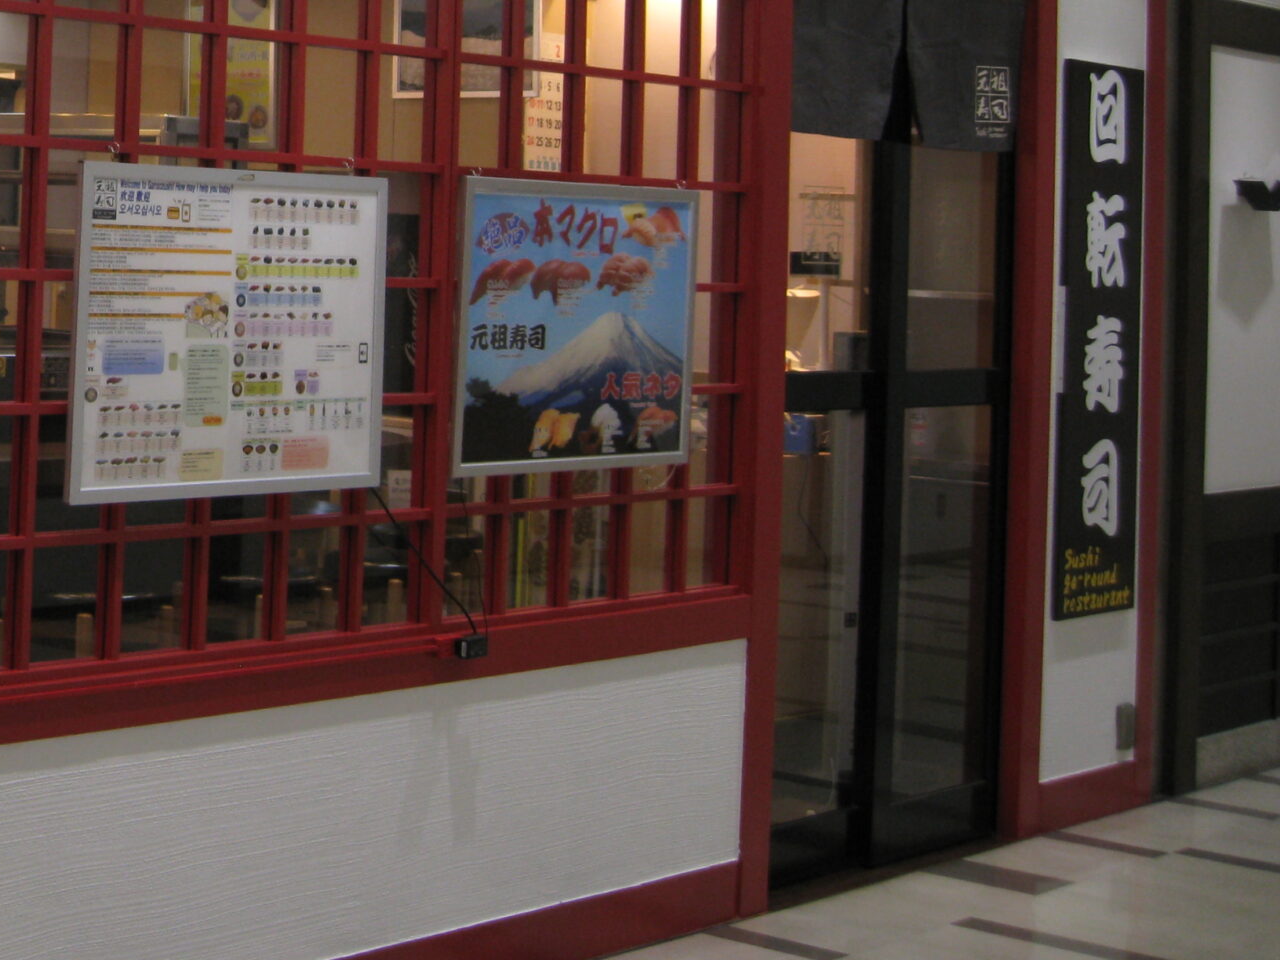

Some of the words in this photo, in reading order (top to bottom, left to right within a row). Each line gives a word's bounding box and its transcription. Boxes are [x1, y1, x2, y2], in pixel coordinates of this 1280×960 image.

[1081, 69, 1128, 538] 回転寿司
[470, 322, 547, 351] 元祖寿司
[599, 372, 682, 401] 人気ネタ
[1063, 545, 1100, 571] Sushi
[1063, 585, 1130, 614] restaurant
